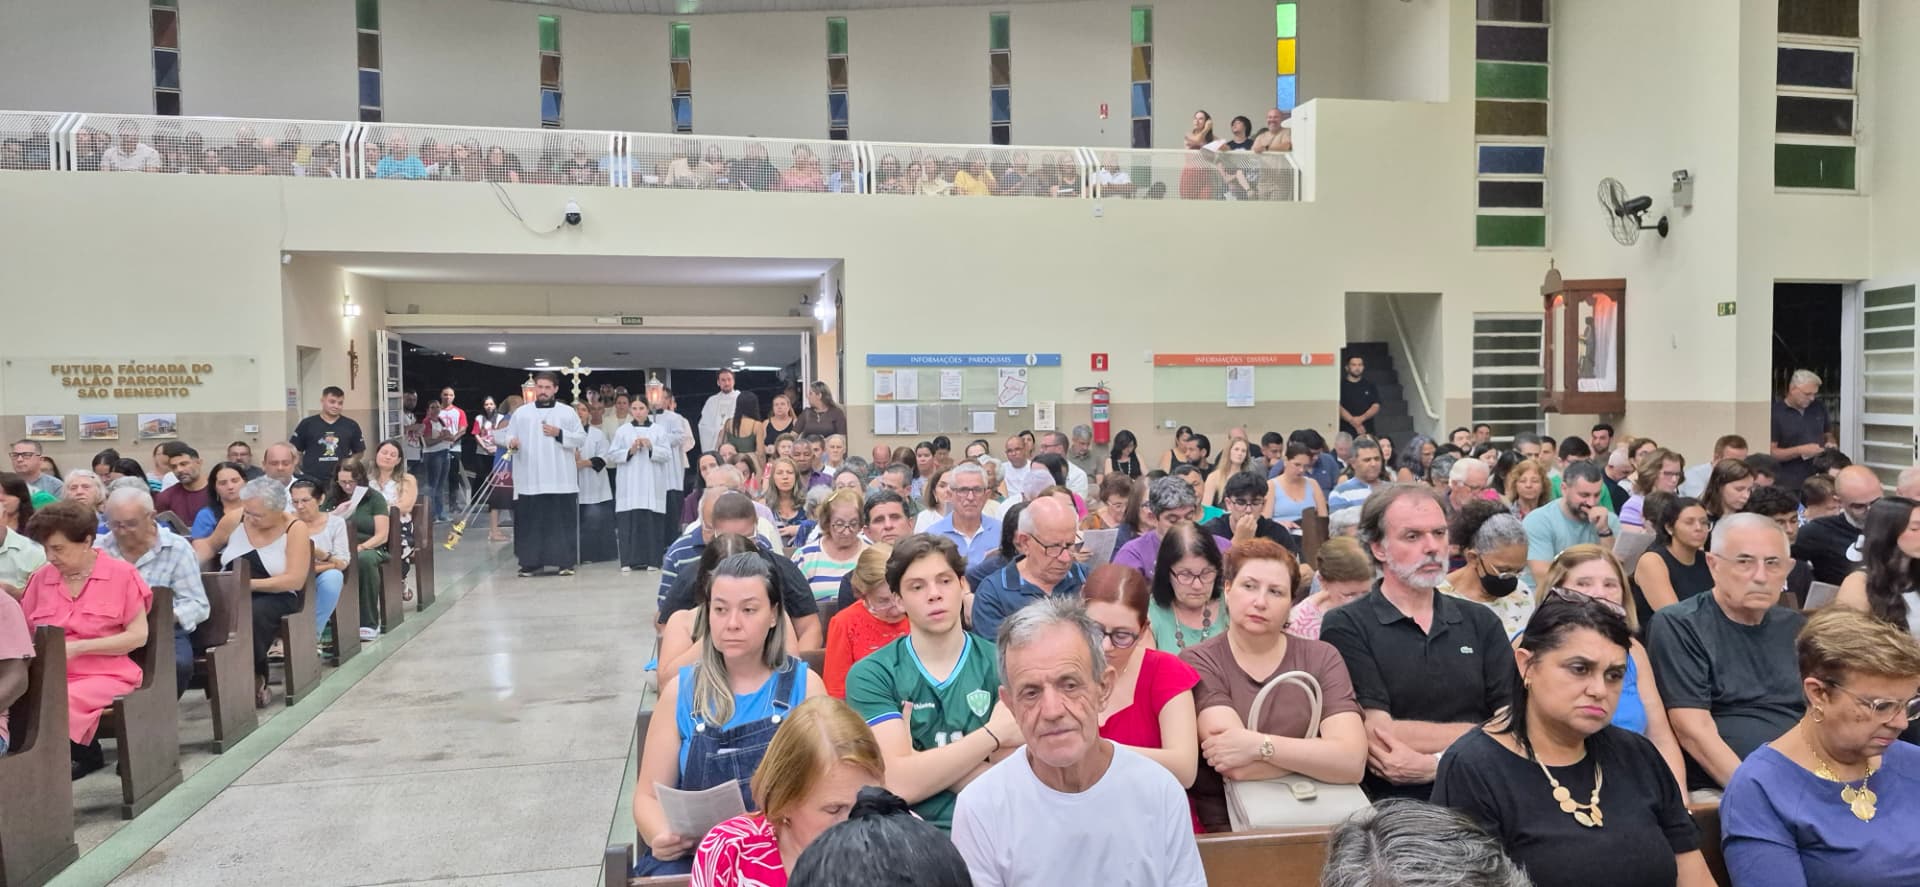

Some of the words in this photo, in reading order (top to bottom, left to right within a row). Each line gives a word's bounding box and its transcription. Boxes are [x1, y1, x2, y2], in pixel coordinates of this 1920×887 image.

[51, 365, 113, 375] FUTURA
[118, 364, 187, 374] FACHADA
[192, 363, 213, 374] DO
[62, 374, 113, 386] SALÃO
[117, 375, 203, 386] PAROQUIAL
[78, 386, 109, 398] SÃO
[113, 387, 189, 398] BENEDITO
